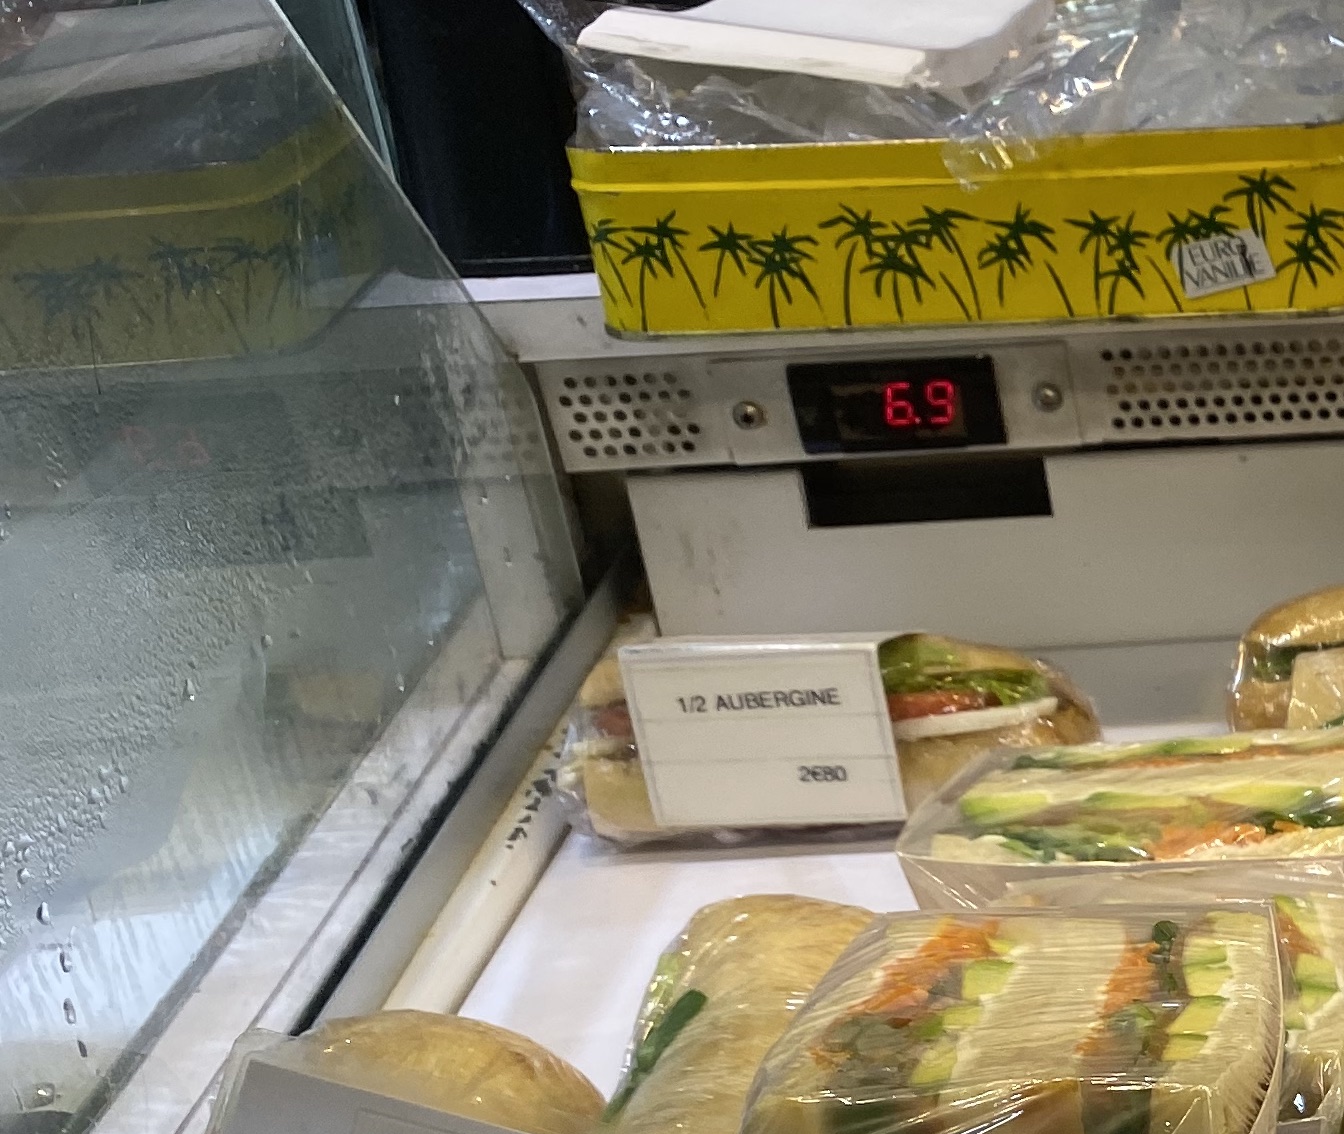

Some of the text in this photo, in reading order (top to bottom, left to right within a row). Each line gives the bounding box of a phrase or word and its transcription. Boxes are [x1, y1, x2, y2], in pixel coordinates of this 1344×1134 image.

[884, 381, 956, 427] 6.9
[676, 687, 842, 713] 1/2 AUBERGINE
